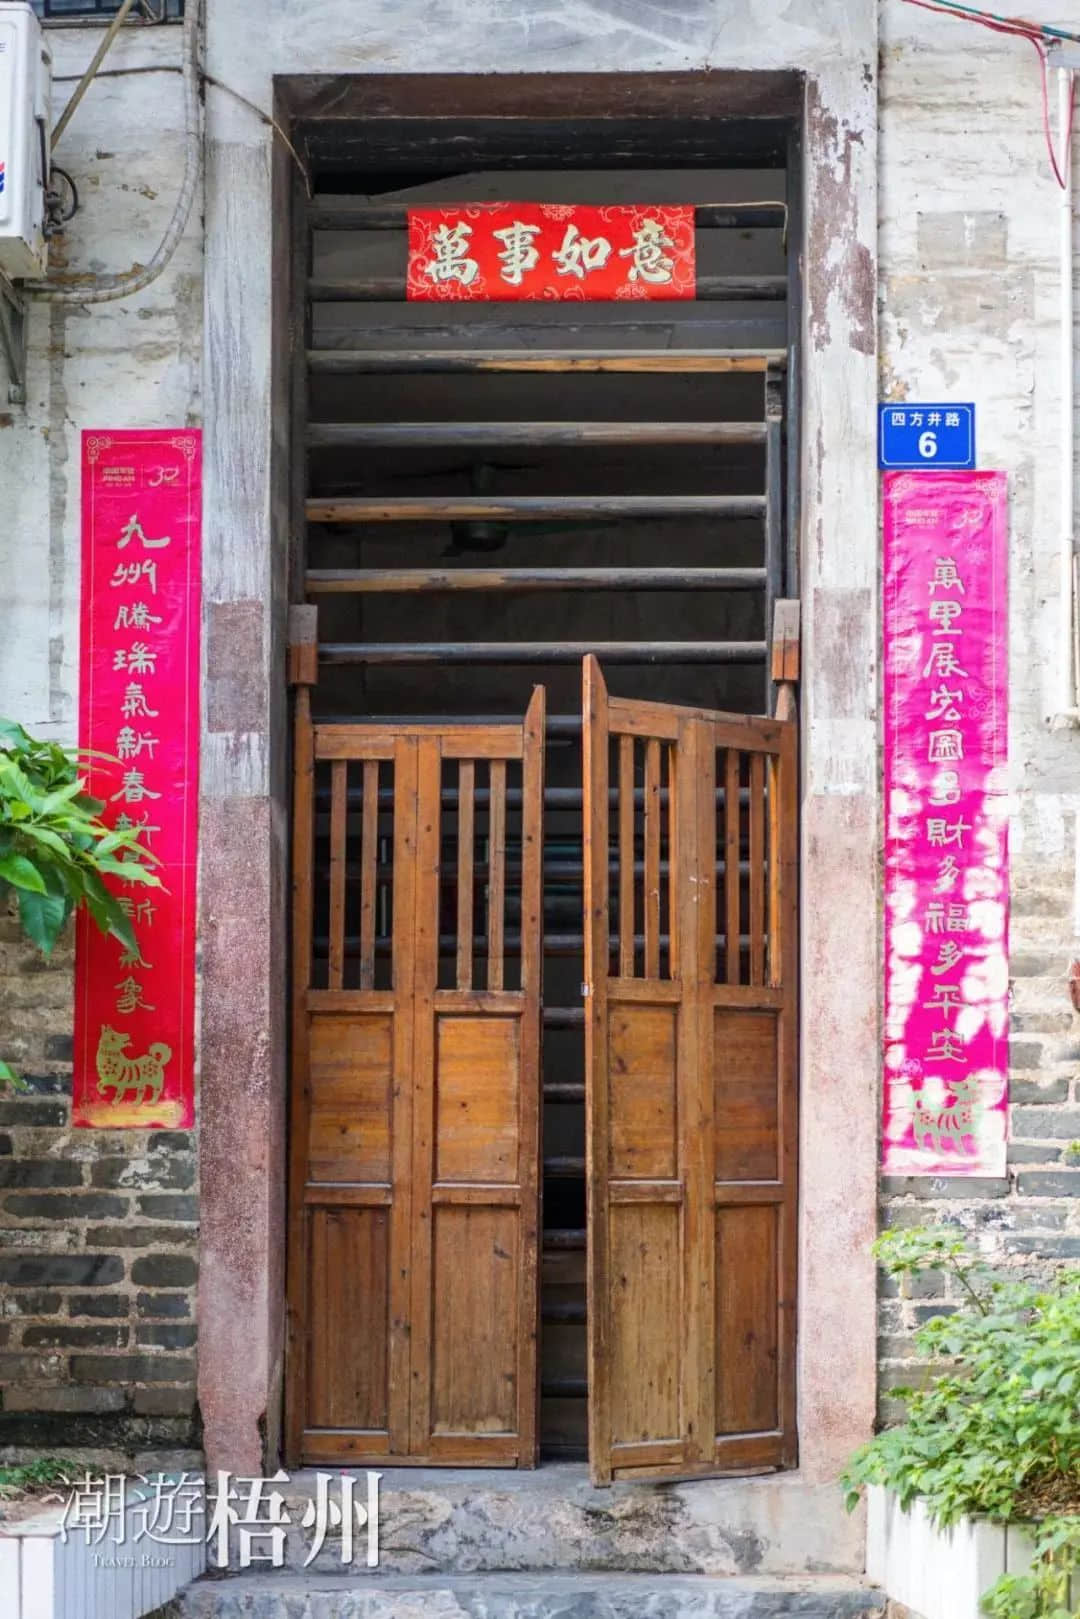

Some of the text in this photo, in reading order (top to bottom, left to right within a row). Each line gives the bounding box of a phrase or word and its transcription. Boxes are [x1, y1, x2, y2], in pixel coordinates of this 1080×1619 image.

[424, 218, 675, 286] 萬事如意
[891, 412, 960, 427] 四方井路
[918, 431, 938, 458] 6
